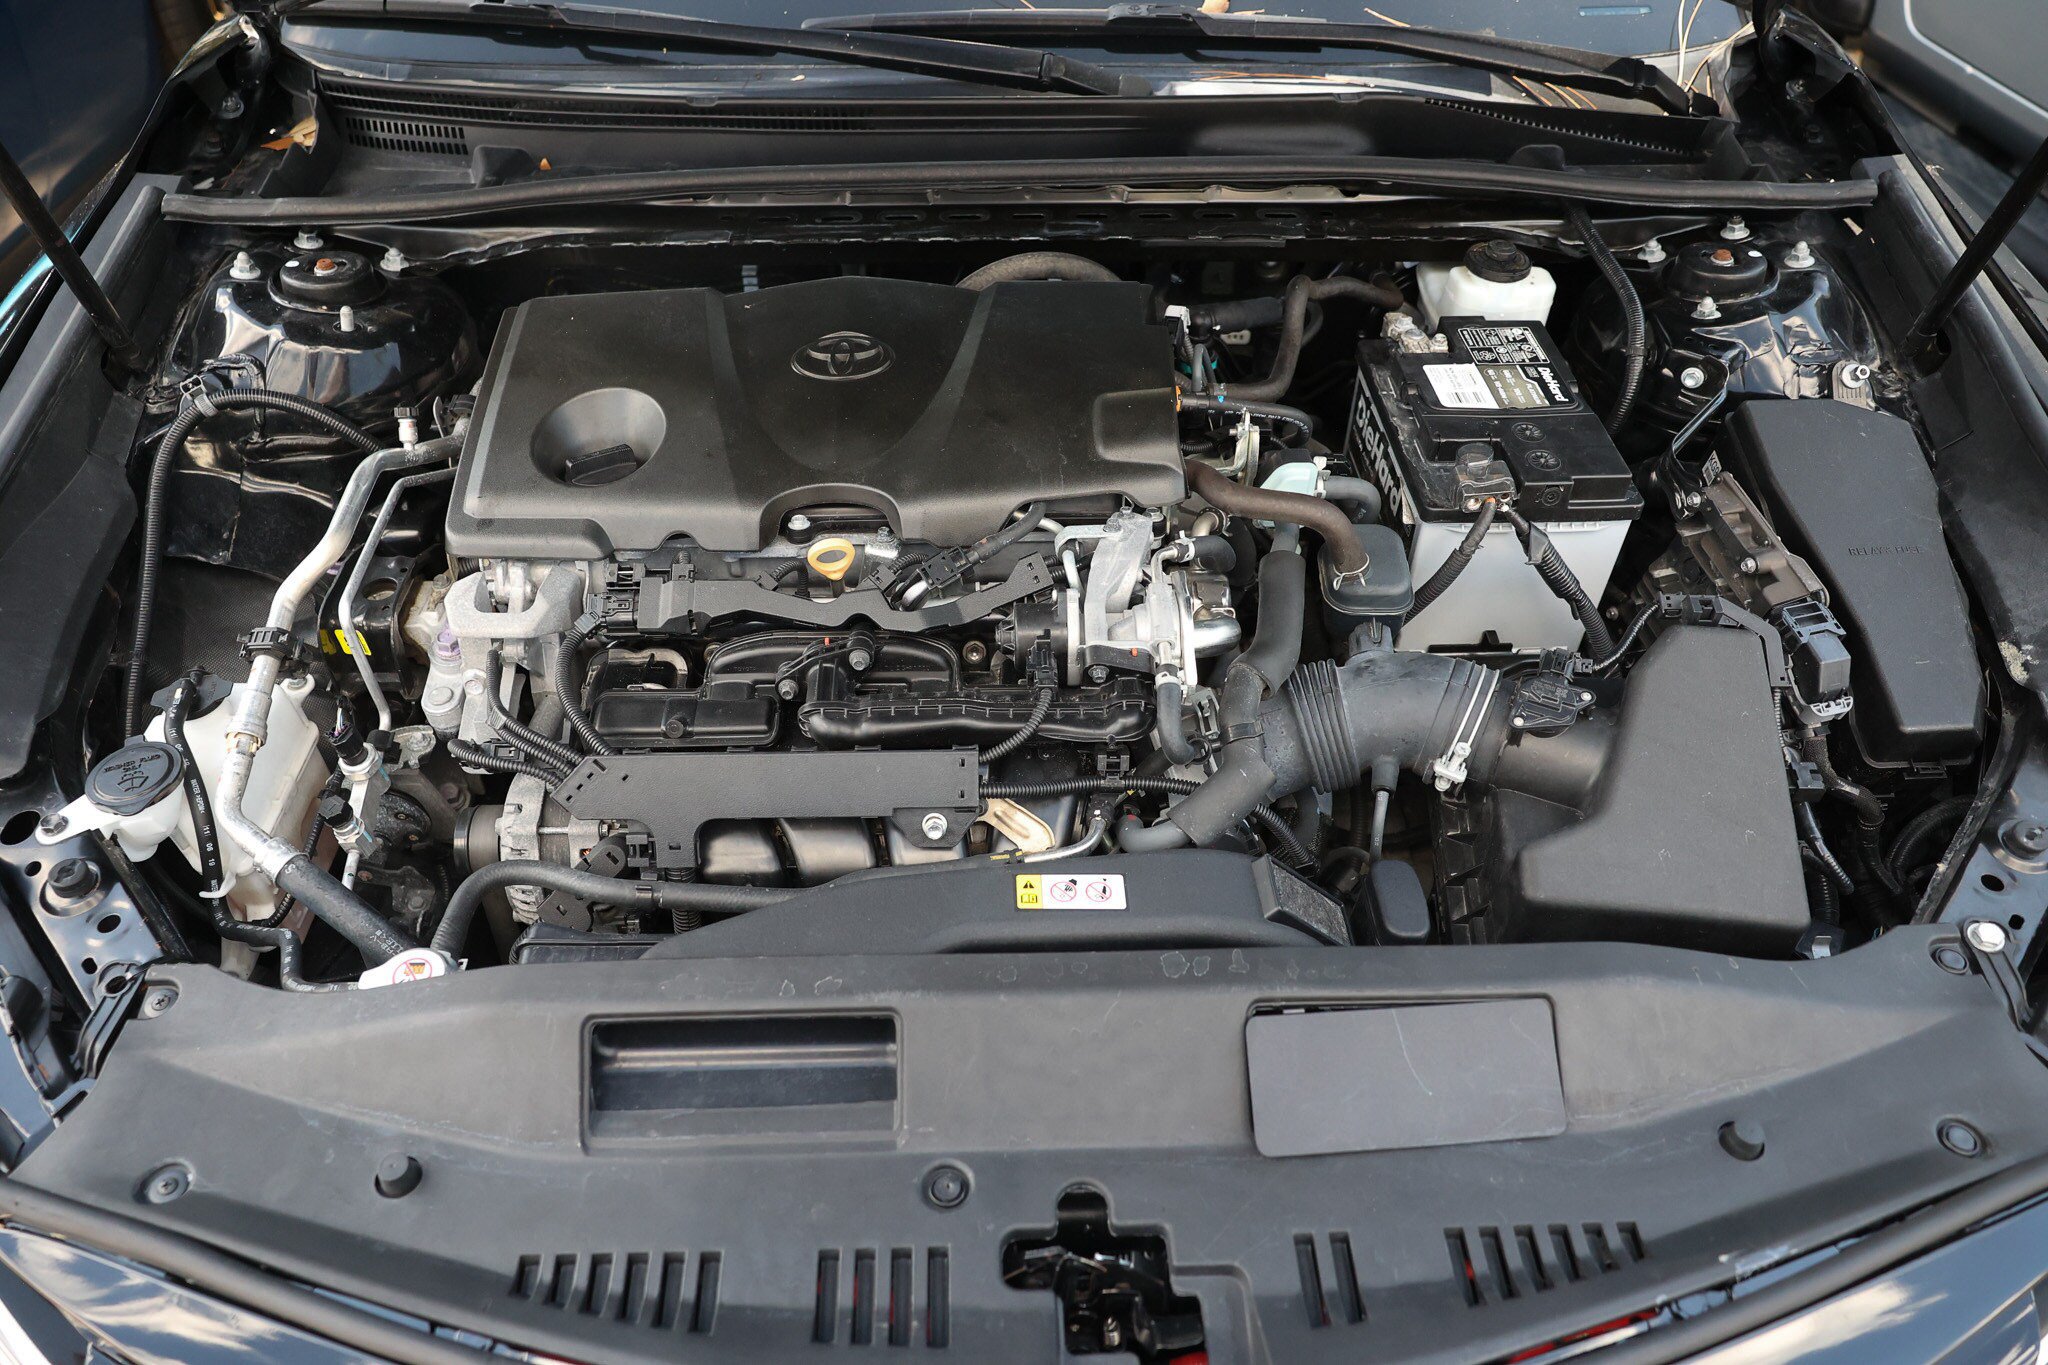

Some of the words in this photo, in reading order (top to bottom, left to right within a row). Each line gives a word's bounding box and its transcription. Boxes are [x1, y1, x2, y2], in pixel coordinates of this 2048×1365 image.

[1537, 367, 1569, 402] DieHard
[1356, 394, 1403, 517] DieHard
[1848, 546, 1883, 556] RELAY
